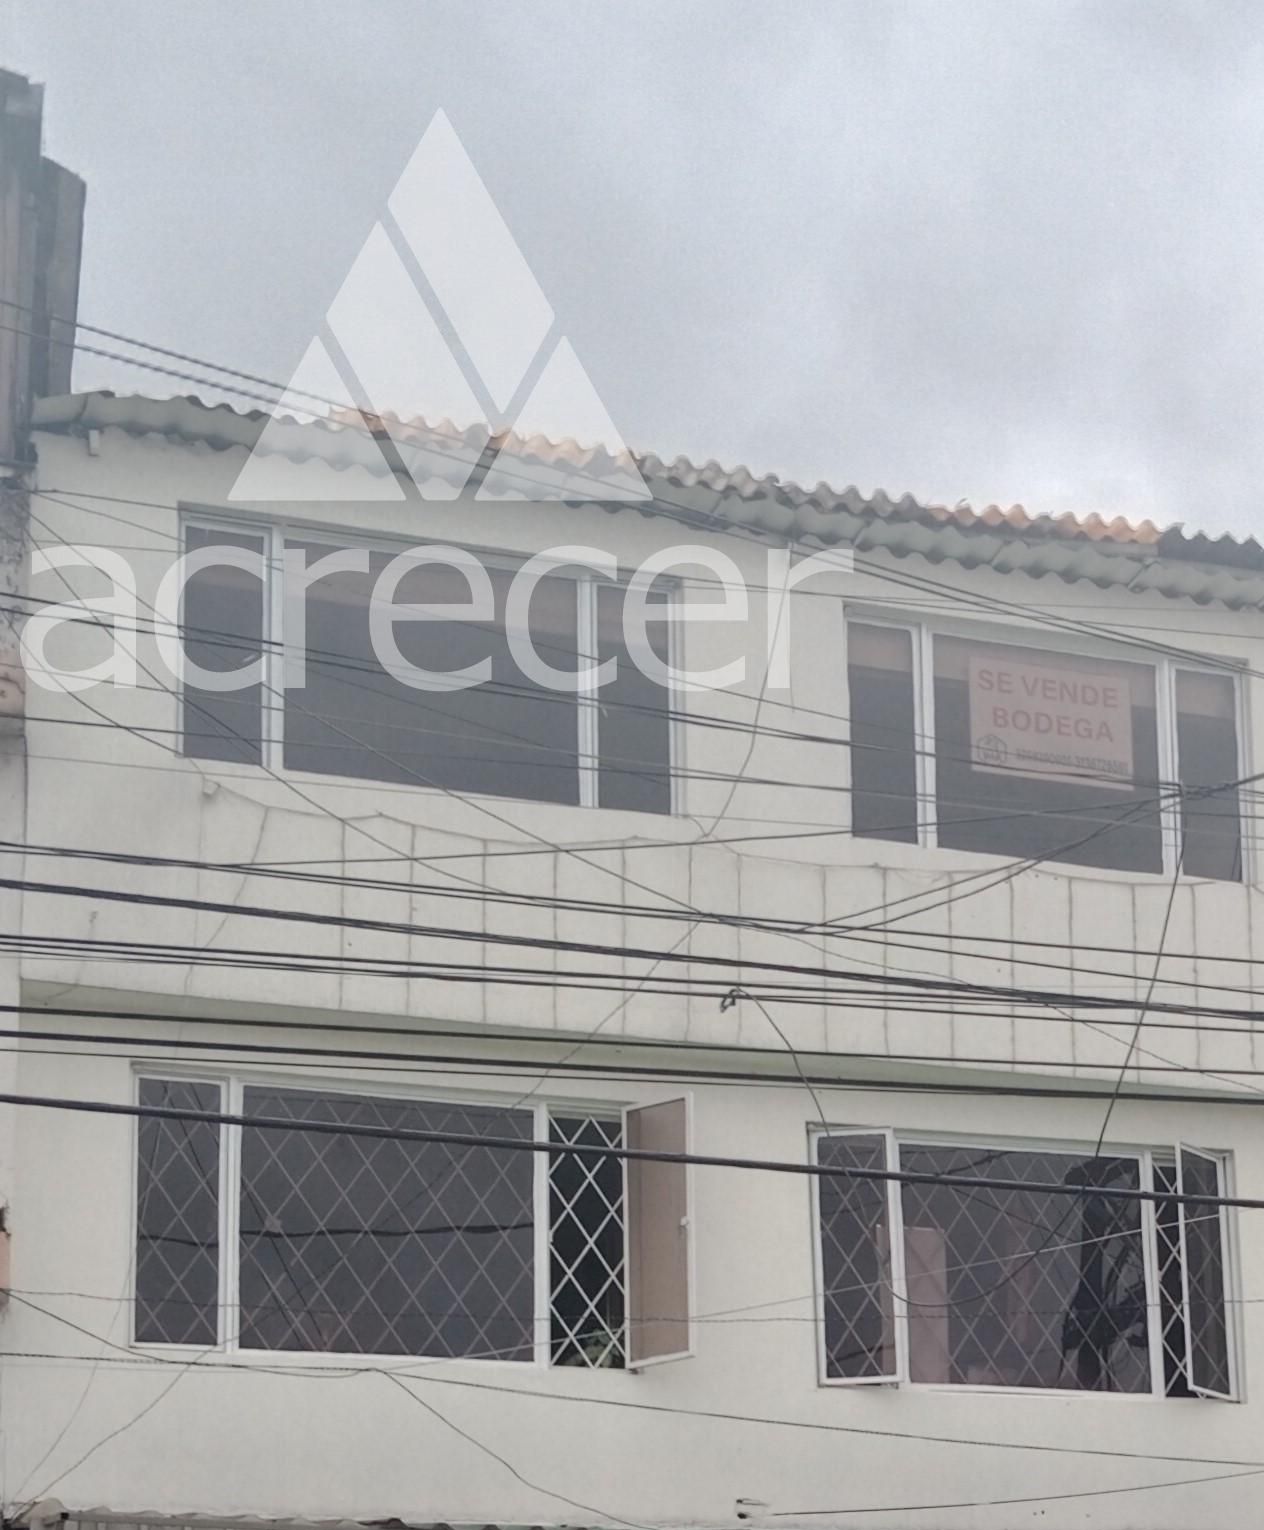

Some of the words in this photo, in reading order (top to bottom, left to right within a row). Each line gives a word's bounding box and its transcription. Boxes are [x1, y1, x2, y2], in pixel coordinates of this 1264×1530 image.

[977, 669, 1014, 694] SE
[1021, 675, 1119, 708] VENDE
[992, 705, 1114, 742] BODEGA
